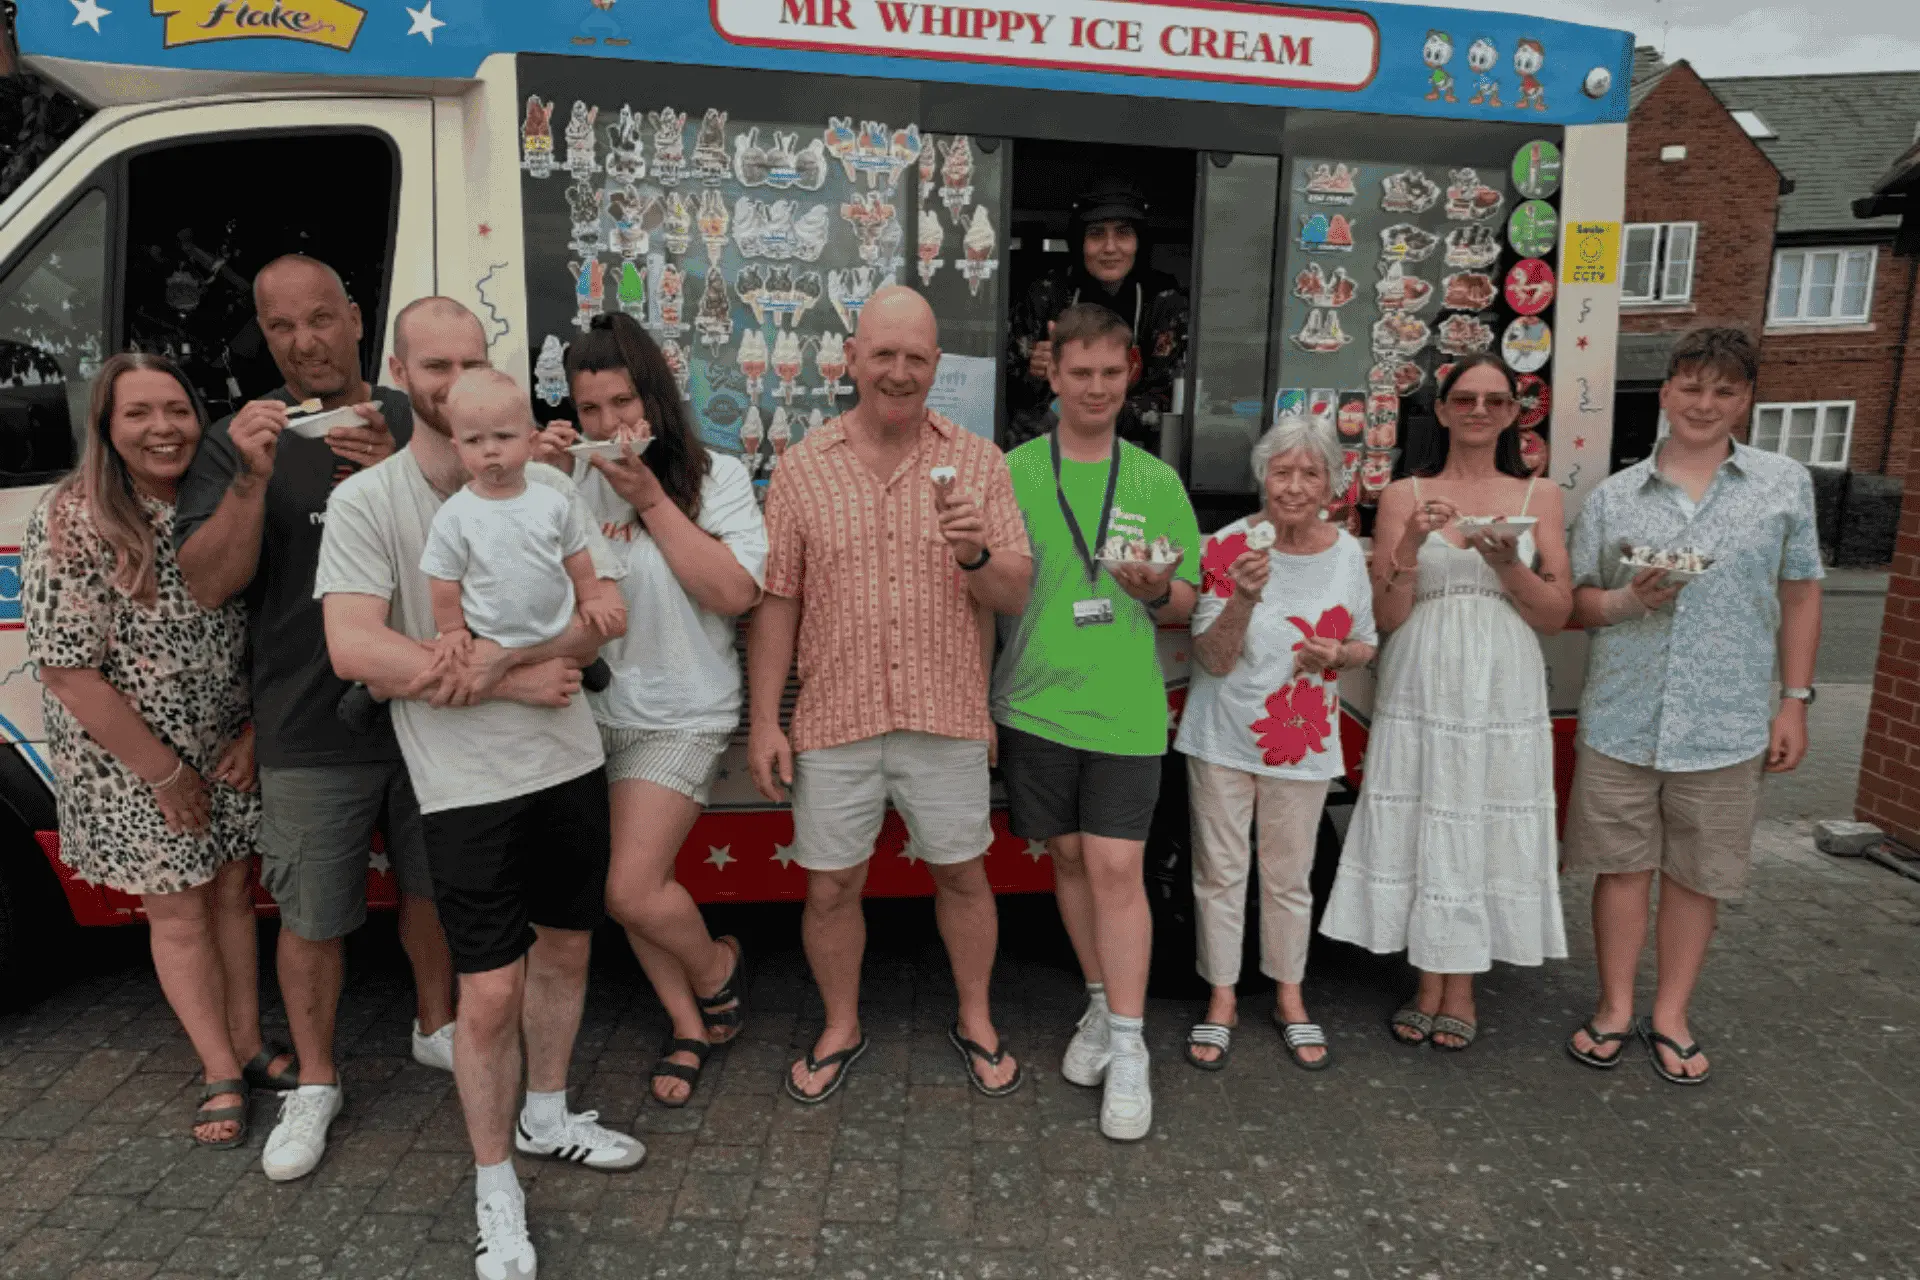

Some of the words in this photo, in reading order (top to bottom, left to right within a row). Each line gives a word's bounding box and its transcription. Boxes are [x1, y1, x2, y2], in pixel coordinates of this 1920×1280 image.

[197, 0, 336, 32] Flake
[779, 0, 858, 30] MR
[875, 1, 1055, 44] WHIPPY
[1069, 16, 1143, 52] ICE
[1159, 24, 1313, 66] CREAM
[1573, 271, 1605, 281] CCTV
